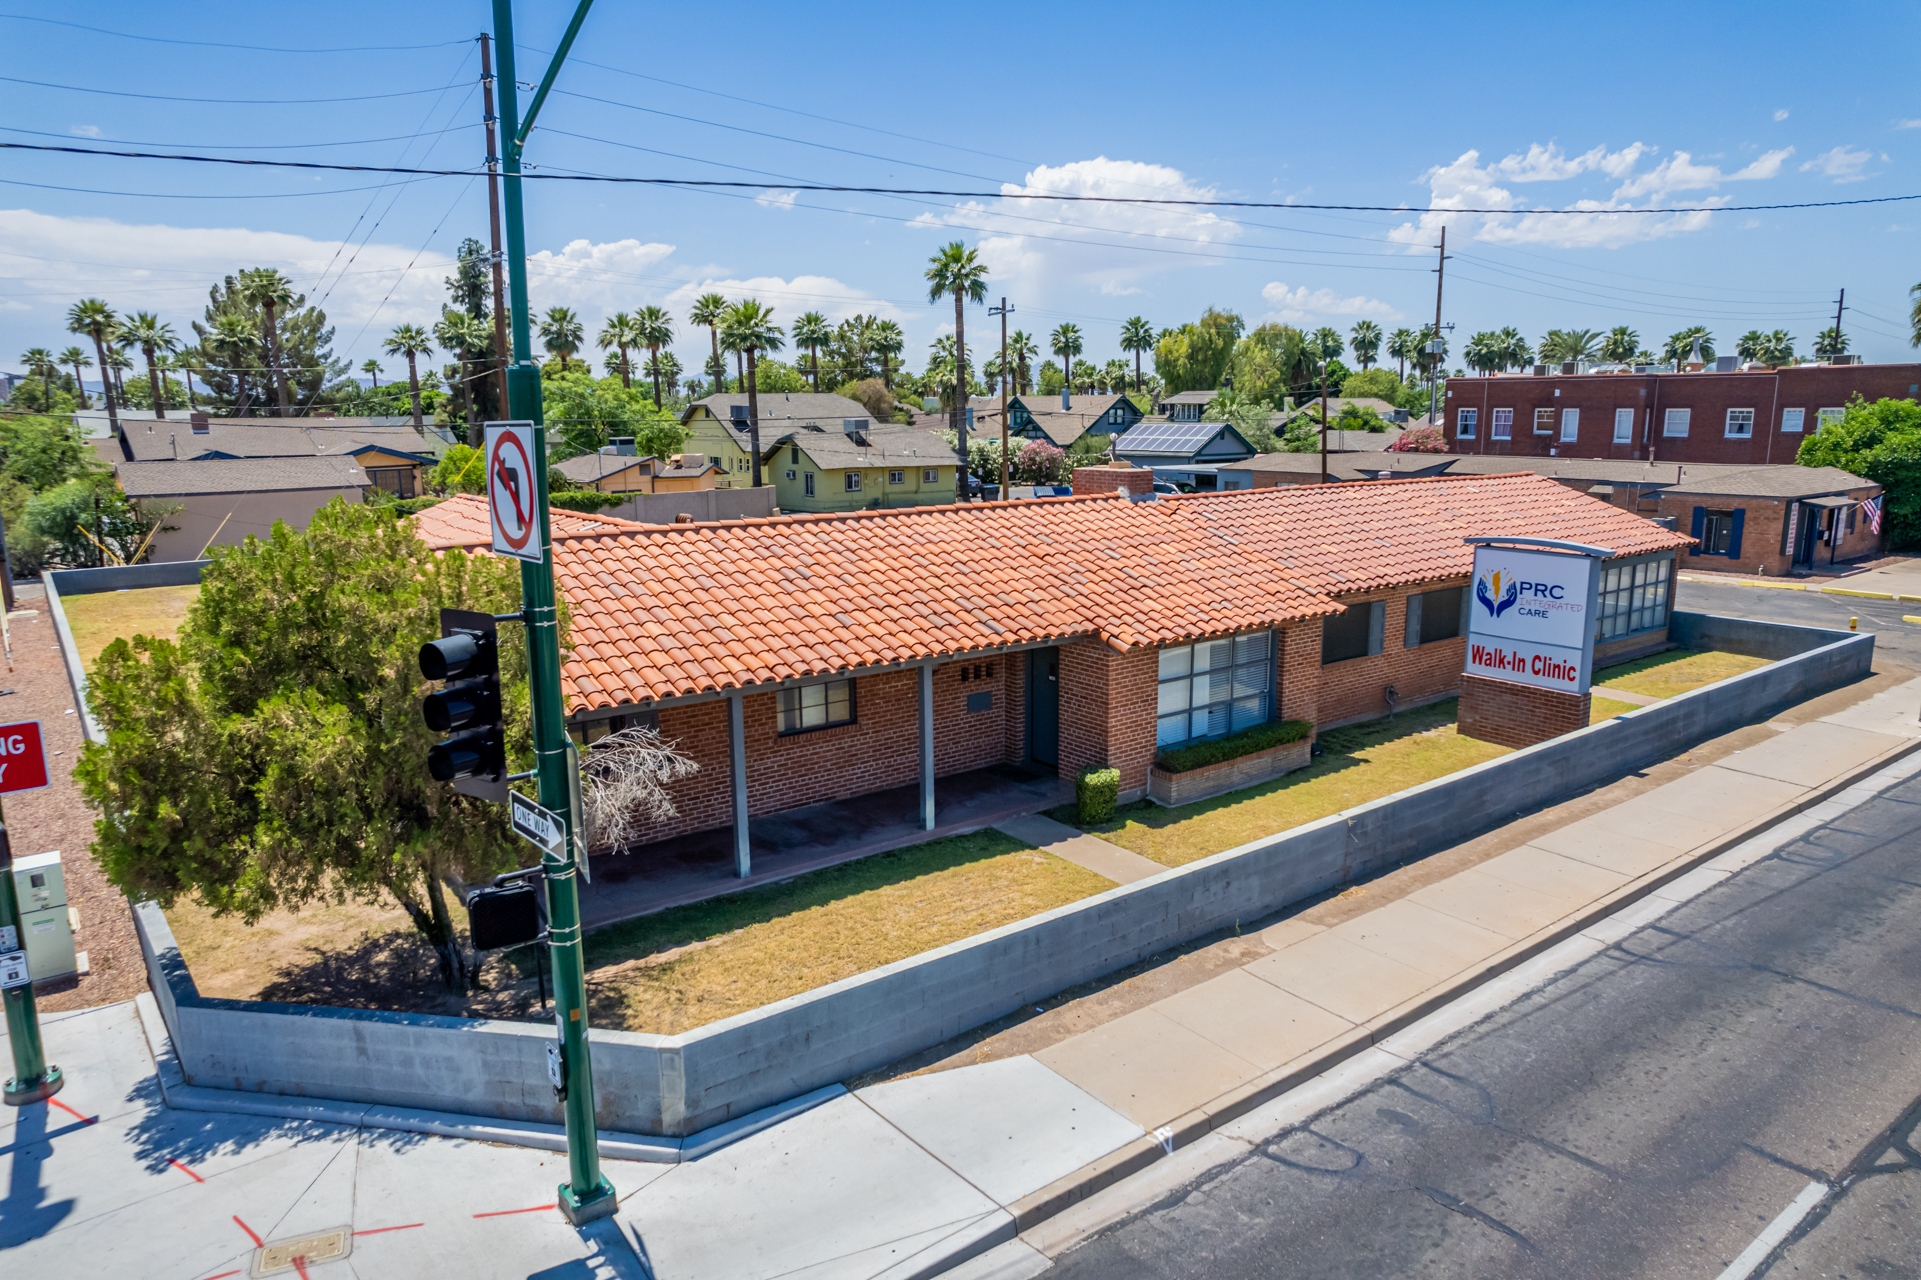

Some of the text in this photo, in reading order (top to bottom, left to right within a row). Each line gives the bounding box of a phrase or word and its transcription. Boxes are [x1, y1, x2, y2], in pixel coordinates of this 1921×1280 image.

[1519, 581, 1565, 600] PRC
[1518, 597, 1583, 613] INTEGRATED
[1518, 607, 1549, 619] CARE
[1471, 644, 1577, 682] Walk-In Clinic
[516, 806, 550, 838] ONE WAY
